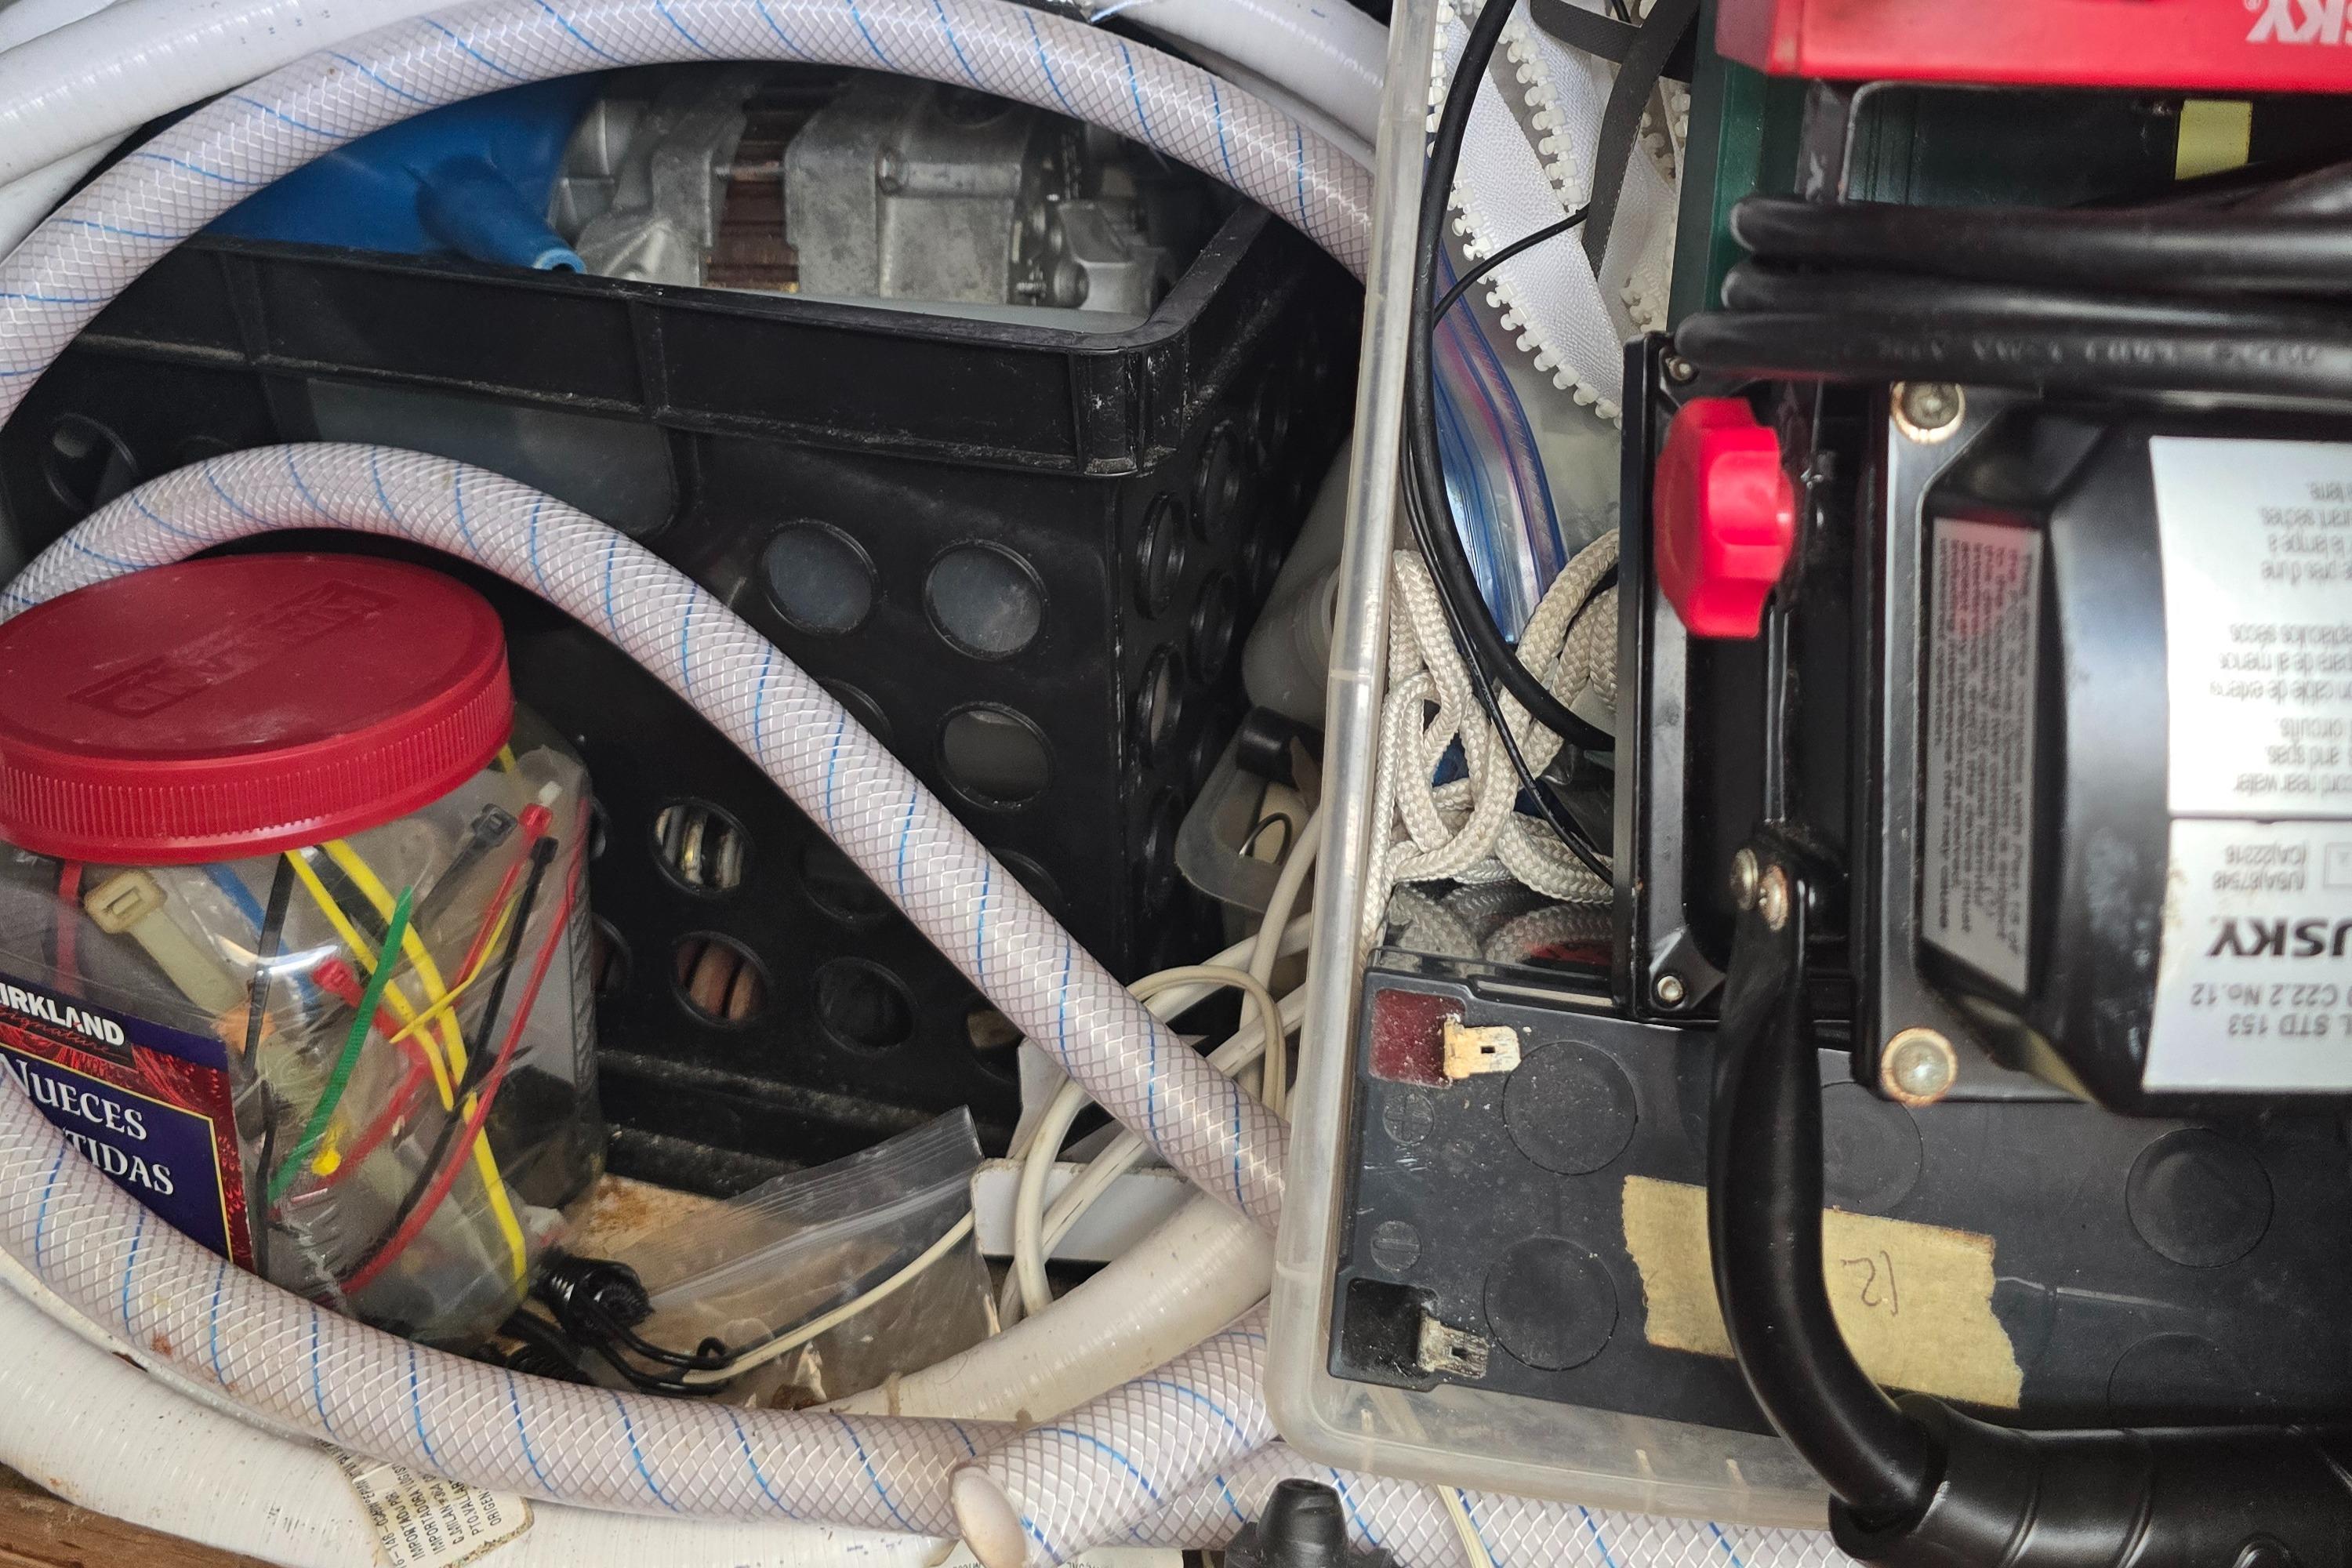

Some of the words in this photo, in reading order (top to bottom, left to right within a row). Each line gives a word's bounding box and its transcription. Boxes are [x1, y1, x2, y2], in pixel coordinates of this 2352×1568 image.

[2245, 0, 2352, 45] KY
[0, 982, 125, 1047] IRKLAND
[2269, 983, 2338, 1009] C22.2
[2227, 1014, 2269, 1038] 153
[2277, 1013, 2330, 1038] STD
[63, 1127, 175, 1196] TIDAS
[408, 1488, 447, 1555] IMPORTADORA
